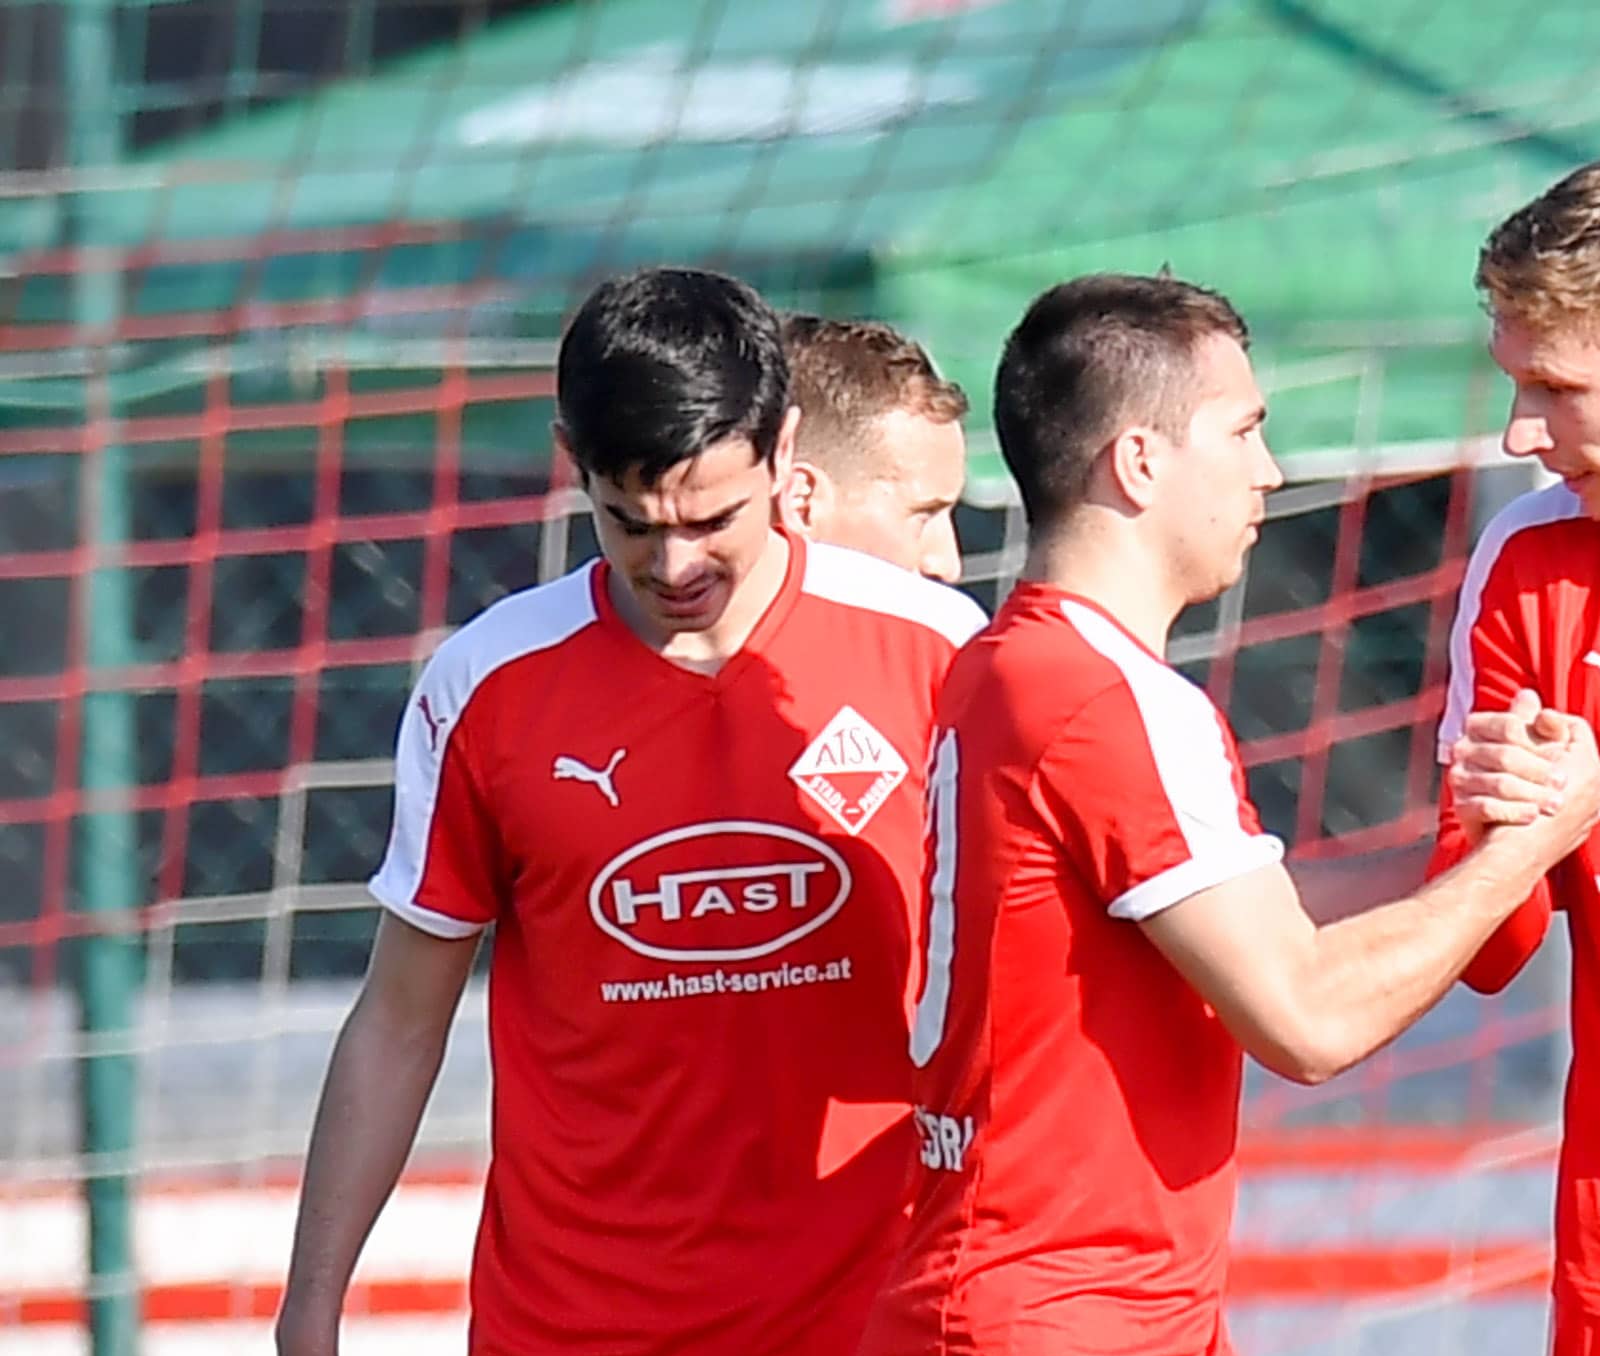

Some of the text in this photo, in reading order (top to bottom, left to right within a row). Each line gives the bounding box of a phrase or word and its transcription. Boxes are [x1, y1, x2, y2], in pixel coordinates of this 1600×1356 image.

[816, 727, 881, 767] ATSV
[612, 862, 825, 924] HAST
[601, 957, 851, 1001] www.hast-service.at
